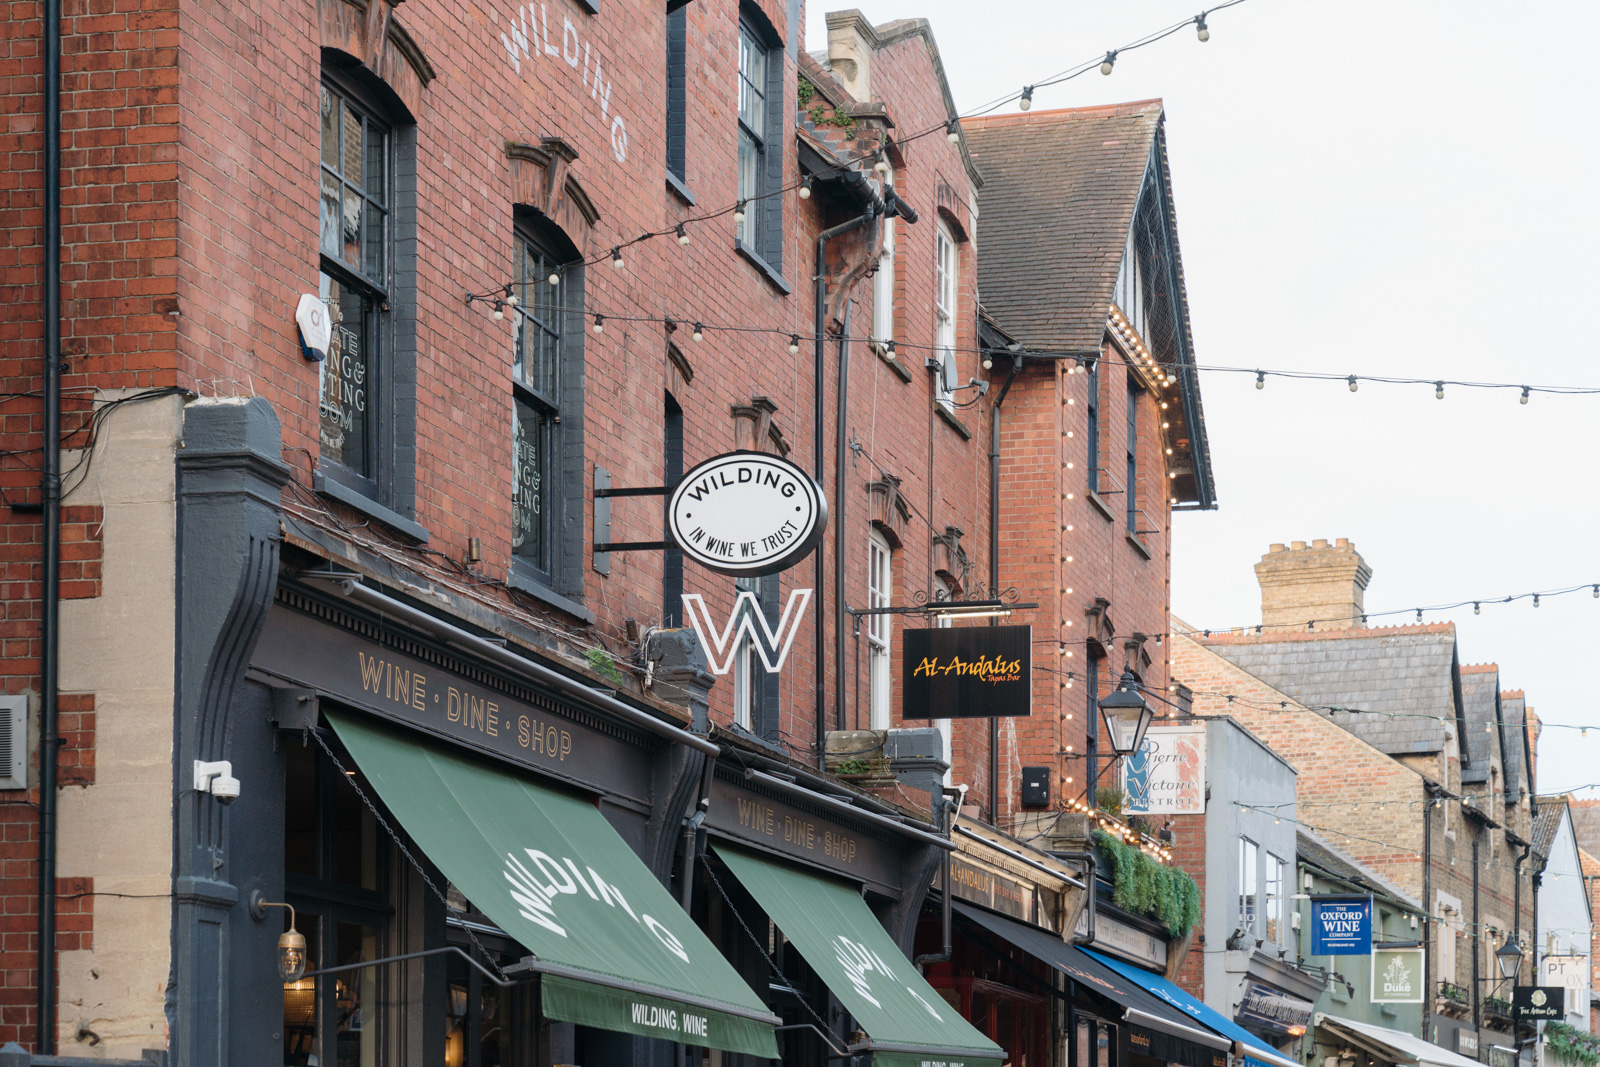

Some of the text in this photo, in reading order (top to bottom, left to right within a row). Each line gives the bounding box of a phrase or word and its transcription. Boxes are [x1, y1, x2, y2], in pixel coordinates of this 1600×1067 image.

[500, 3, 628, 163] WILDING
[331, 324, 358, 357] ATE
[322, 367, 365, 412] ETING
[353, 362, 366, 384] &
[319, 399, 353, 432] OOM
[512, 482, 540, 514] TING
[688, 467, 797, 502] WILDING
[689, 520, 798, 558] IN WINE WE TRUST
[681, 589, 813, 675] W
[913, 654, 1021, 682] Al-Andalus
[987, 673, 1021, 686] Tapas Bar
[359, 652, 572, 761] WINE DINE SHOP
[1127, 762, 1195, 799] Victoire
[738, 797, 856, 863] WINE DINE SHOP
[503, 847, 690, 964] WILDING
[1320, 911, 1363, 921] OXFORD
[1323, 921, 1360, 932] WINE
[1548, 963, 1566, 975] PT
[1566, 974, 1583, 986] OX
[1383, 982, 1411, 992] Duke
[683, 1013, 708, 1037] WINE
